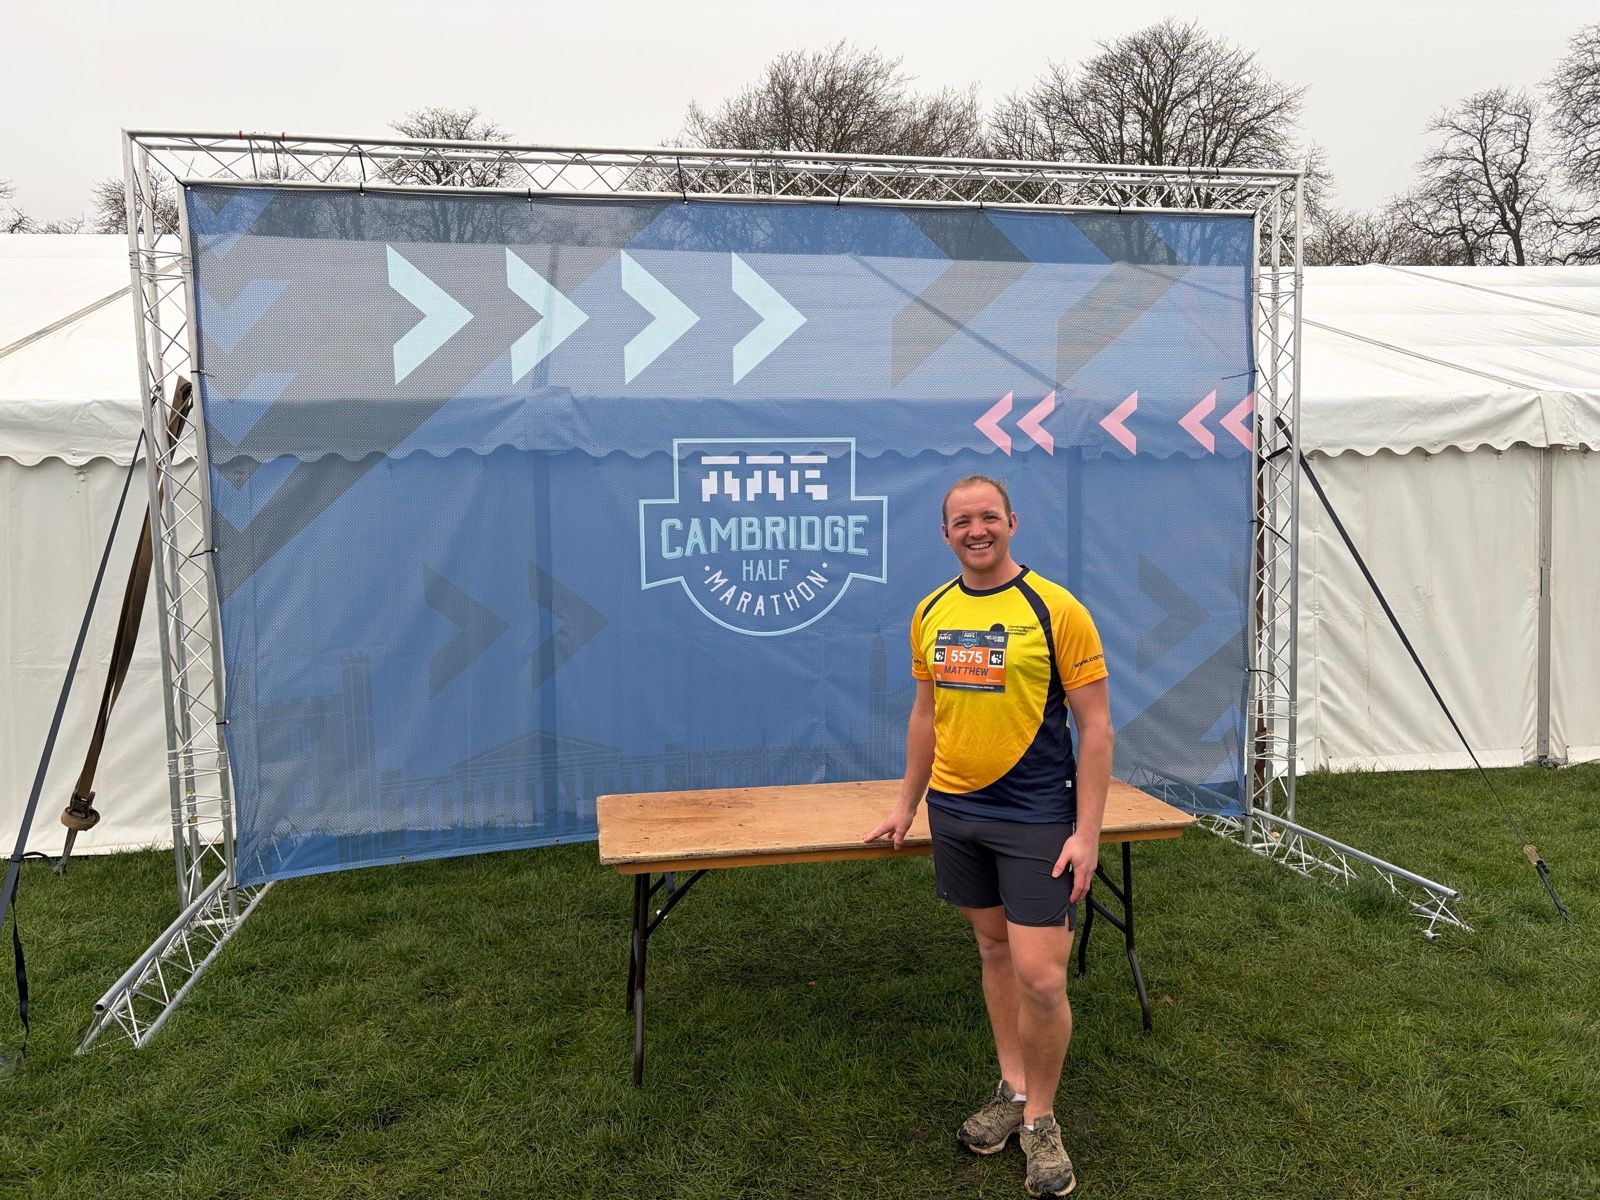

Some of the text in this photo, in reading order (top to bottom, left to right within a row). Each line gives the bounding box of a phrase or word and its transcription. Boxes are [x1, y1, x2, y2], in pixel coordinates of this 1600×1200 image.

[661, 515, 869, 560] CAMBRIDGE
[742, 559, 790, 582] HALF
[704, 569, 829, 616] MARATHON
[950, 649, 983, 664] 5575
[944, 666, 989, 677] MATTHEW
